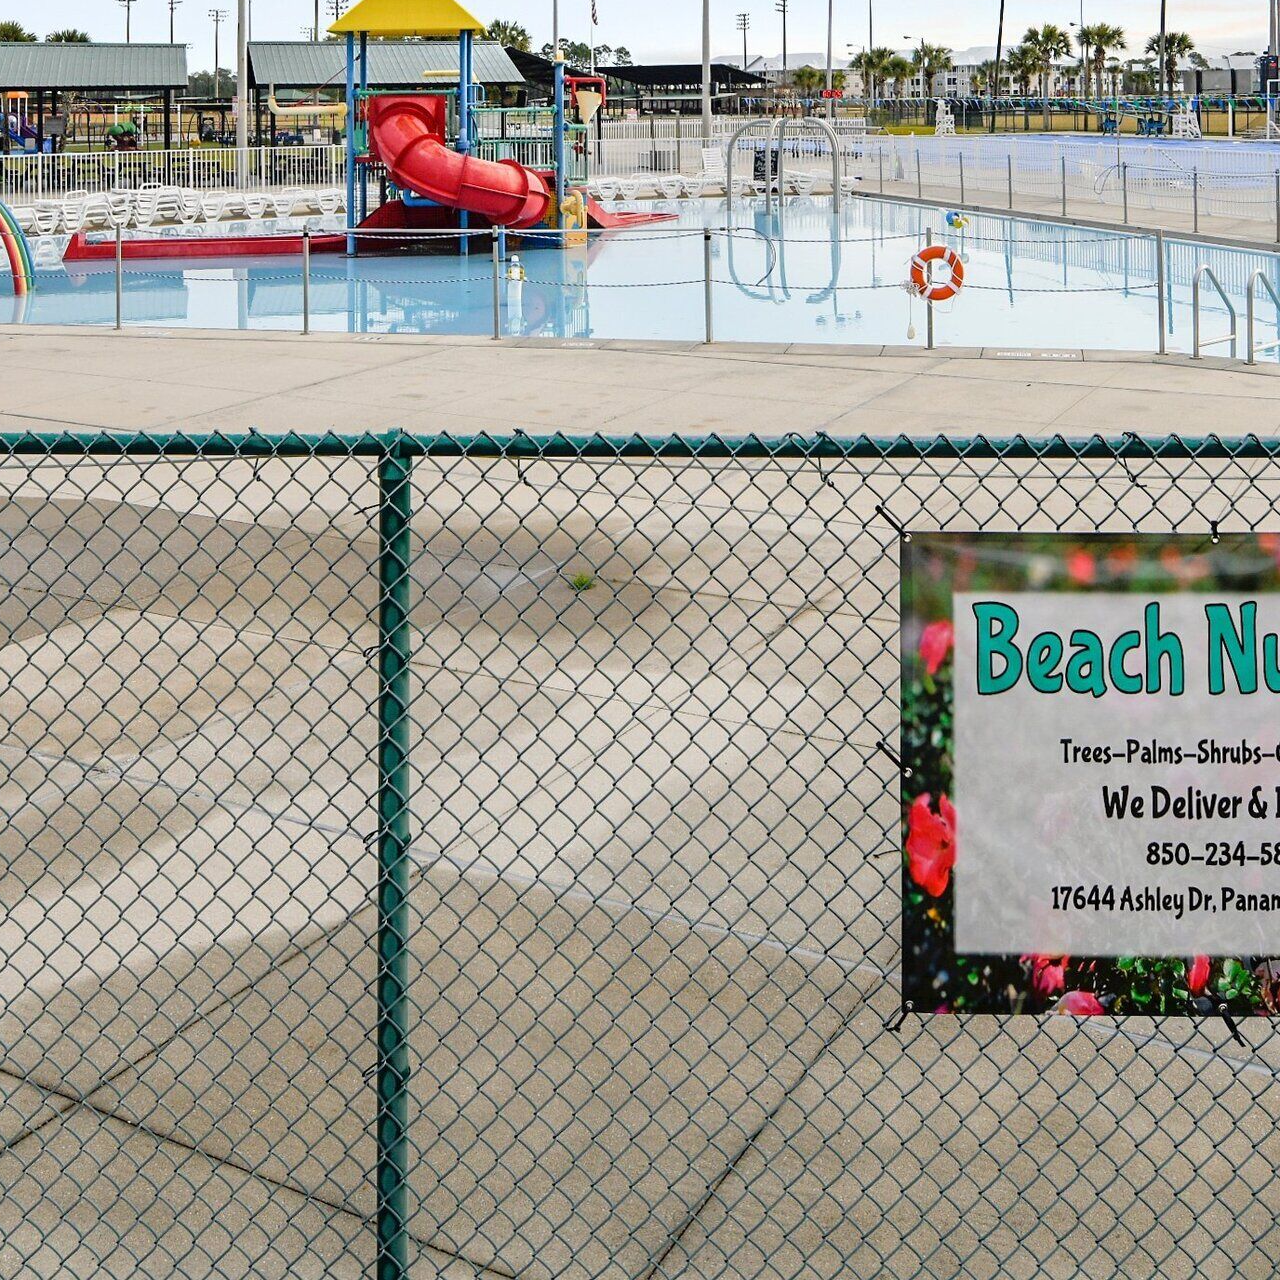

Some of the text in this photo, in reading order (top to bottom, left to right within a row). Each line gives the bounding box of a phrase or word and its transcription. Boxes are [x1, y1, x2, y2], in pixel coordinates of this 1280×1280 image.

[972, 600, 1185, 699] Beach
[1102, 784, 1145, 820] We
[1150, 785, 1243, 821] Deliver
[1247, 785, 1268, 820] &
[1051, 884, 1116, 912] 17644
[1119, 885, 1184, 920] Ashley
[1188, 886, 1218, 913] Dr,
